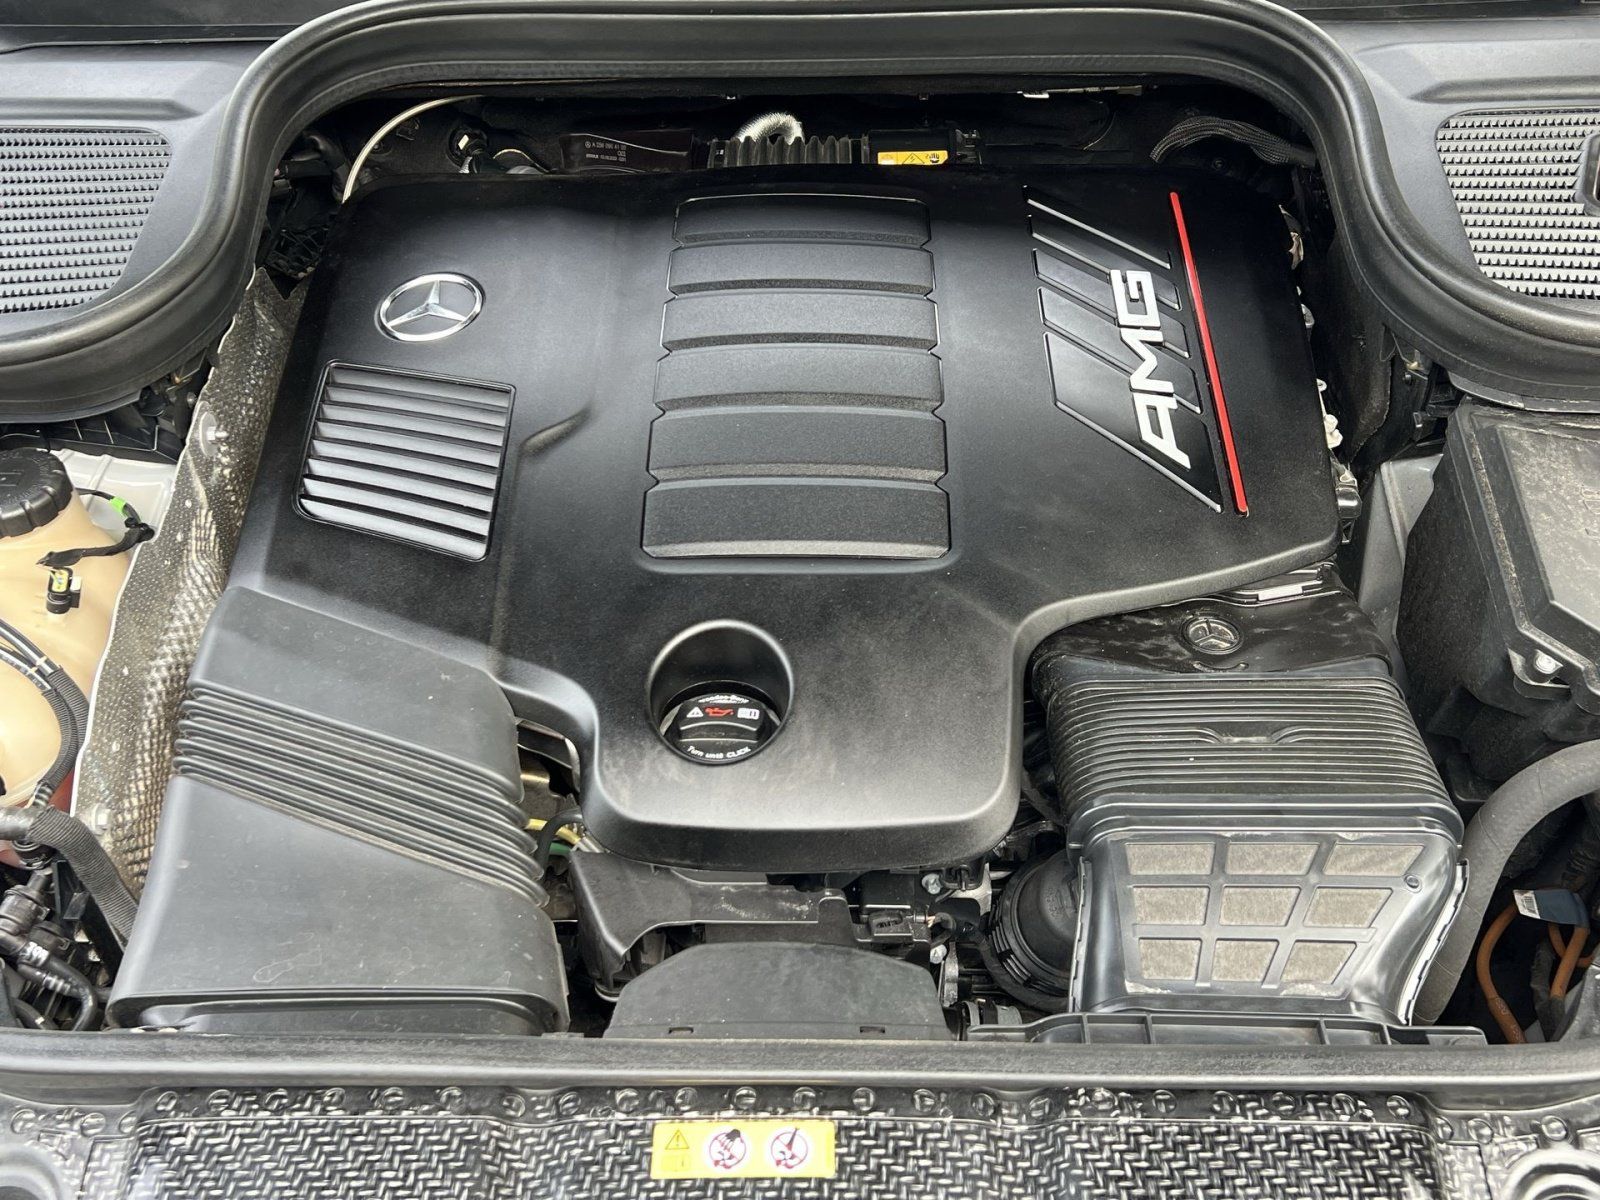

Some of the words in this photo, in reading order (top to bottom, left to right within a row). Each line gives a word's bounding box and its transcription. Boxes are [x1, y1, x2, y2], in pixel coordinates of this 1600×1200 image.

[1110, 269, 1191, 469] AMG
[687, 745, 704, 757] Turn
[726, 746, 752, 758] CLICK
